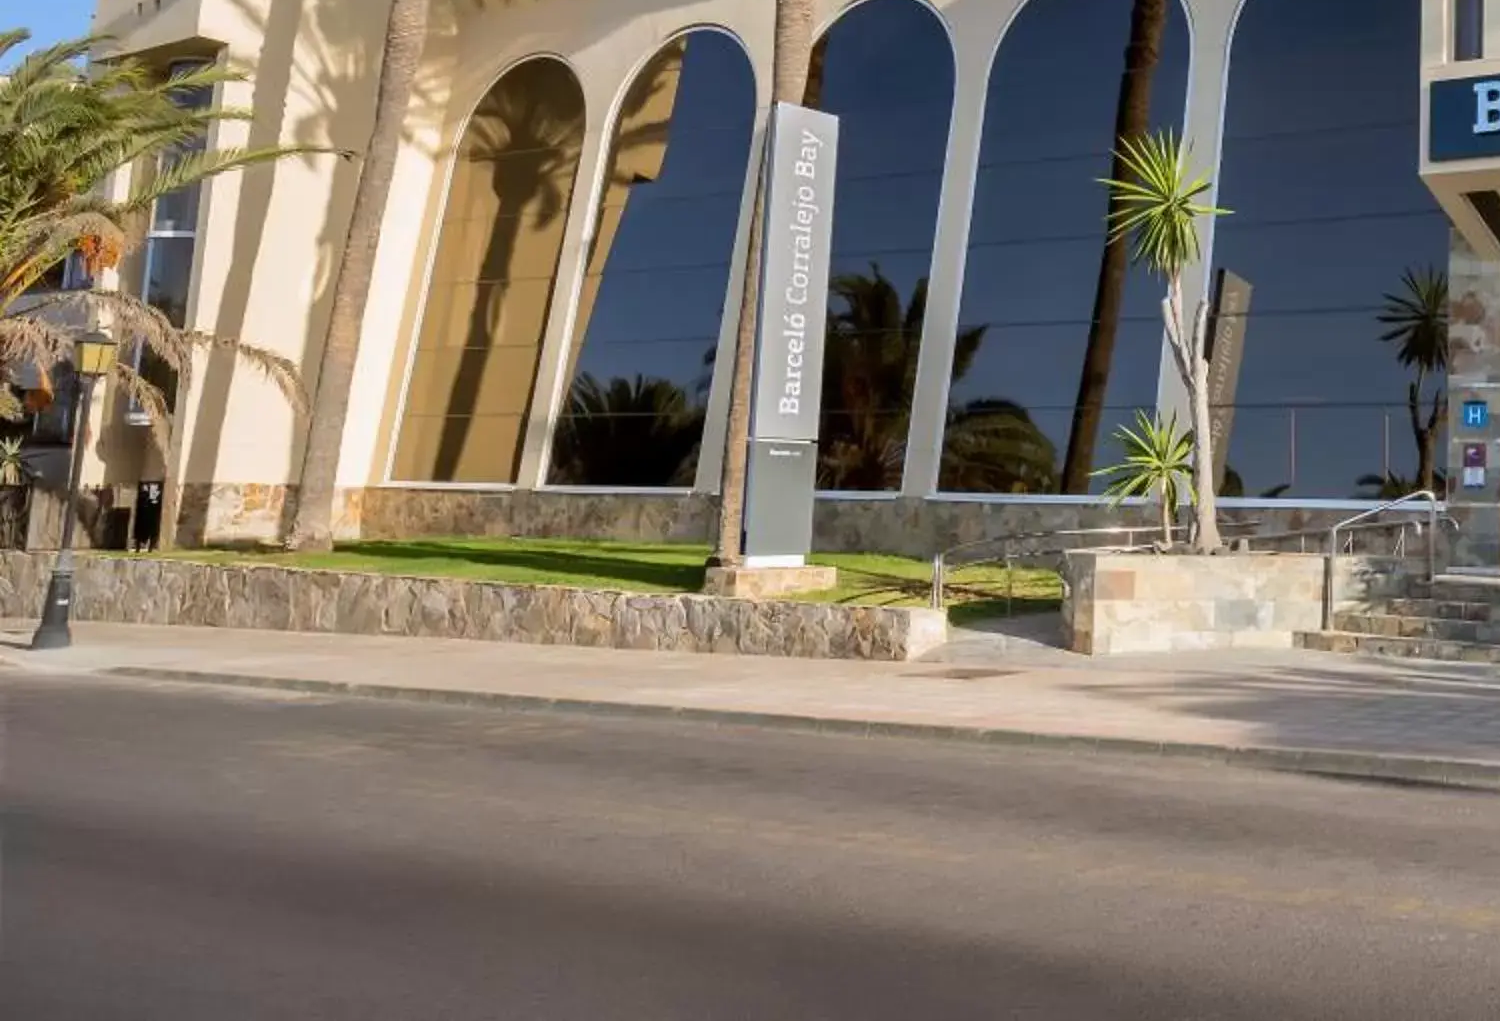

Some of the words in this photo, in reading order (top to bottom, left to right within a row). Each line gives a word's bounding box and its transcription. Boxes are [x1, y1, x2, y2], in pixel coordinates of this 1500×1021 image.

[793, 127, 824, 180] Bay
[785, 185, 820, 305] Corralejo
[778, 312, 806, 416] Barceló
[1467, 405, 1481, 424] H
